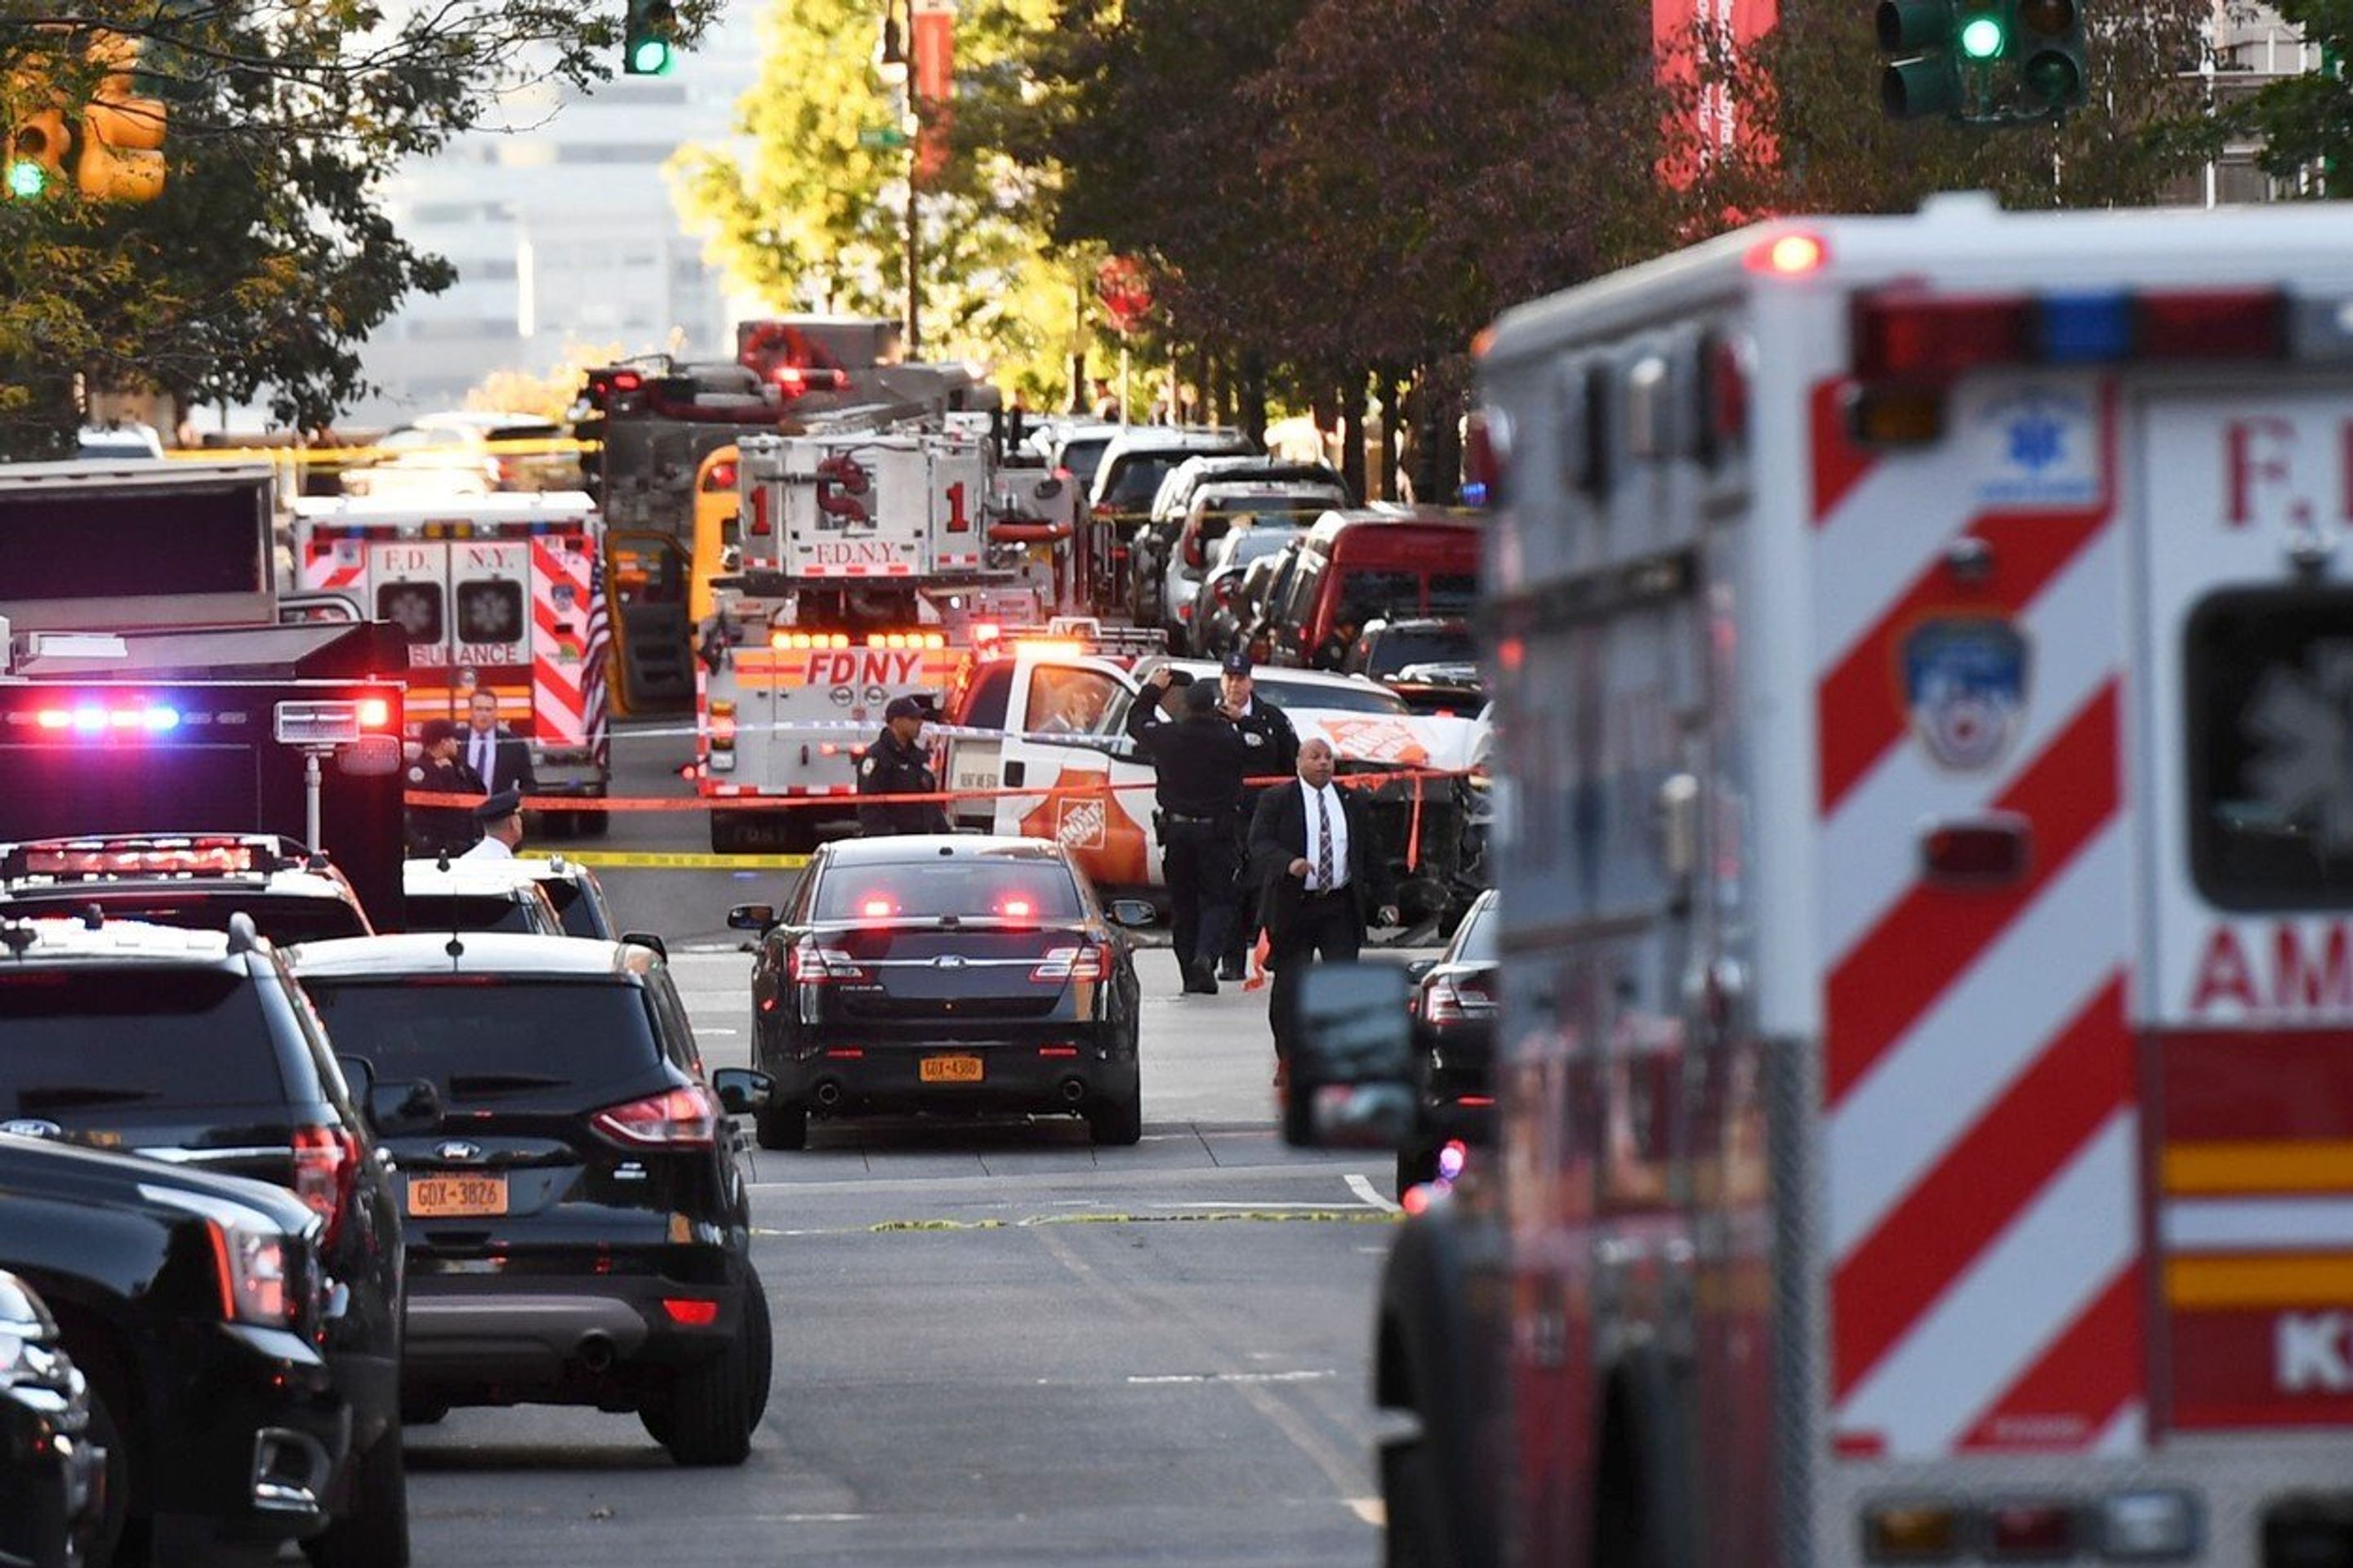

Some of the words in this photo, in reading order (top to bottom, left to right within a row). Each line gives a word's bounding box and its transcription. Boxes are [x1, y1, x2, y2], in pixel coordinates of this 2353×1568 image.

[2222, 415, 2353, 527] F.
[751, 485, 771, 536] 1
[946, 482, 969, 532] 1
[385, 550, 431, 570] F.D.
[468, 548, 515, 569] N.Y.
[818, 542, 899, 564] F.D.N.Y.
[412, 644, 517, 665] BULANCE
[807, 653, 920, 685] FDNY
[417, 1182, 497, 1206] GDX-3826
[2279, 1313, 2353, 1391] K
